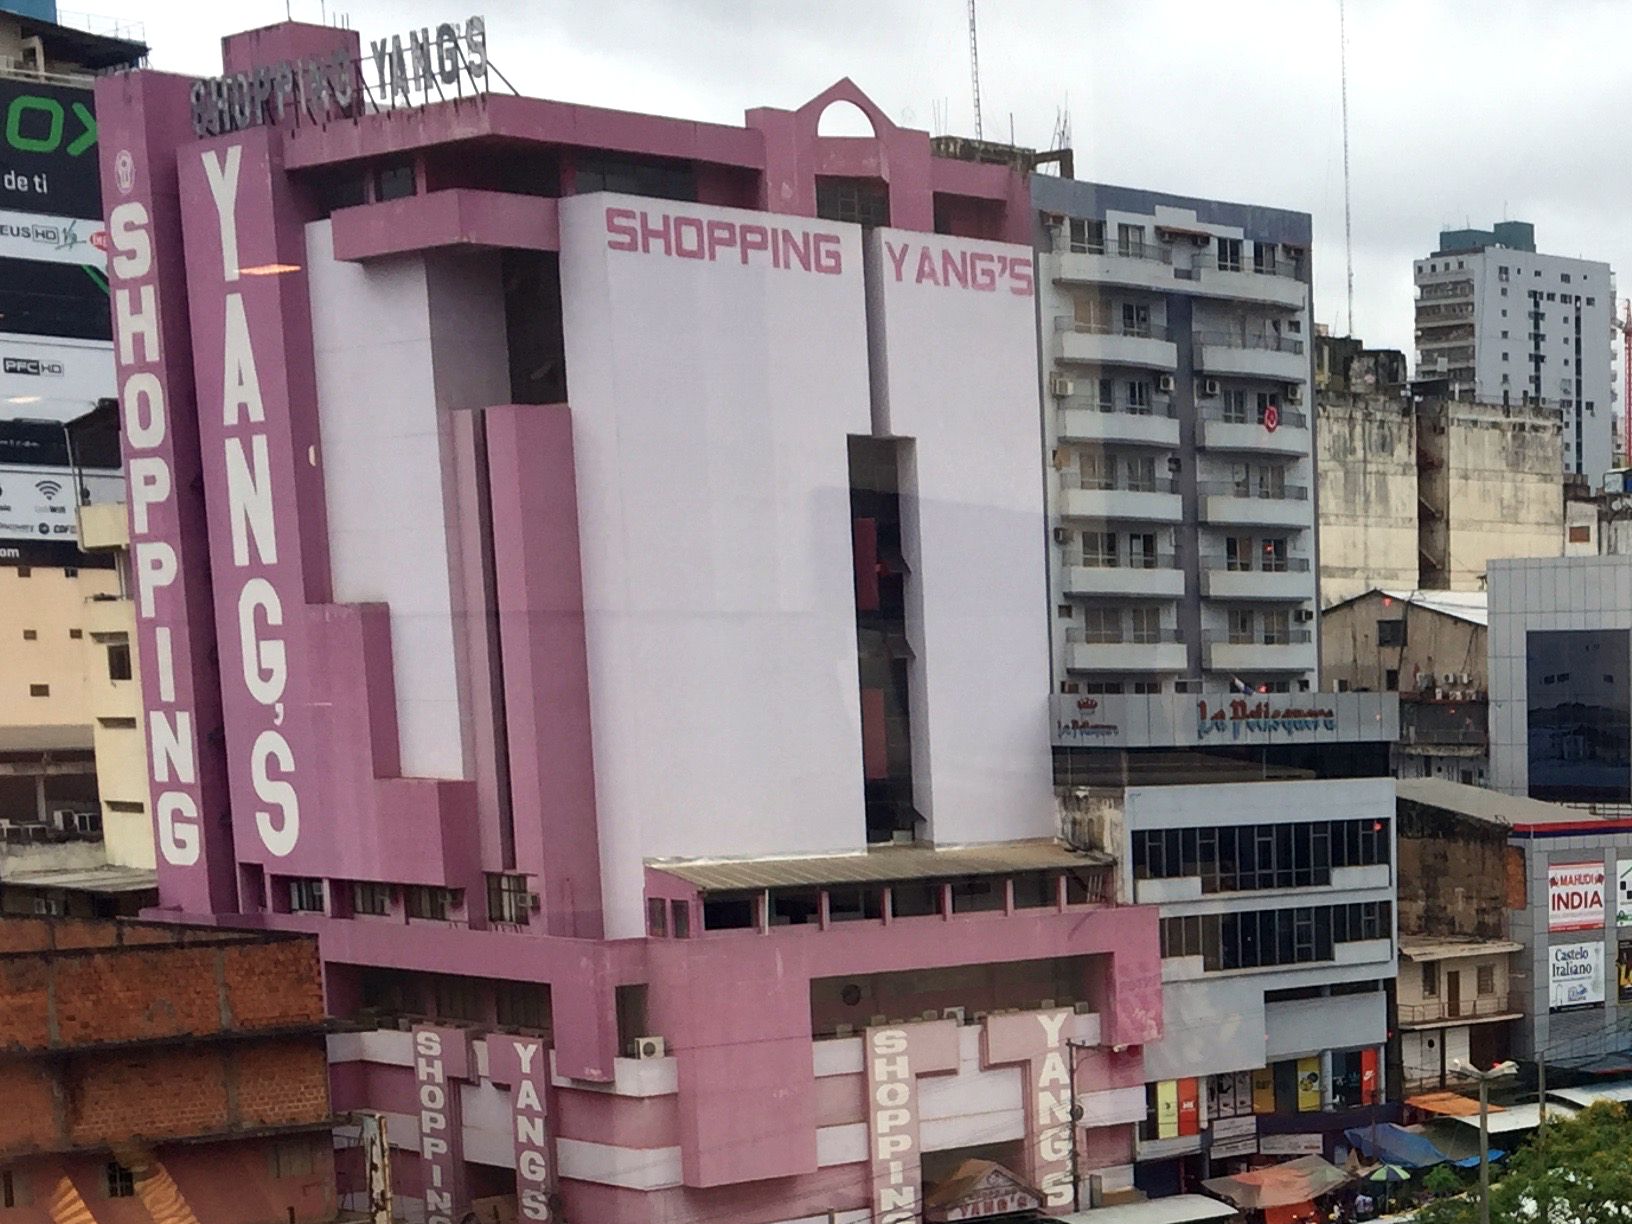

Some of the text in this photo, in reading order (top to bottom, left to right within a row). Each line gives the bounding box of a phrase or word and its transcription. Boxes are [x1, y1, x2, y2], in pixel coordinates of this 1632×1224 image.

[605, 206, 1035, 296] SHOPPING YANG'S
[109, 202, 199, 865] SHOPPING
[1552, 891, 1603, 911] INDIA
[1555, 946, 1589, 962] Castelo
[1552, 961, 1592, 977] Italiano
